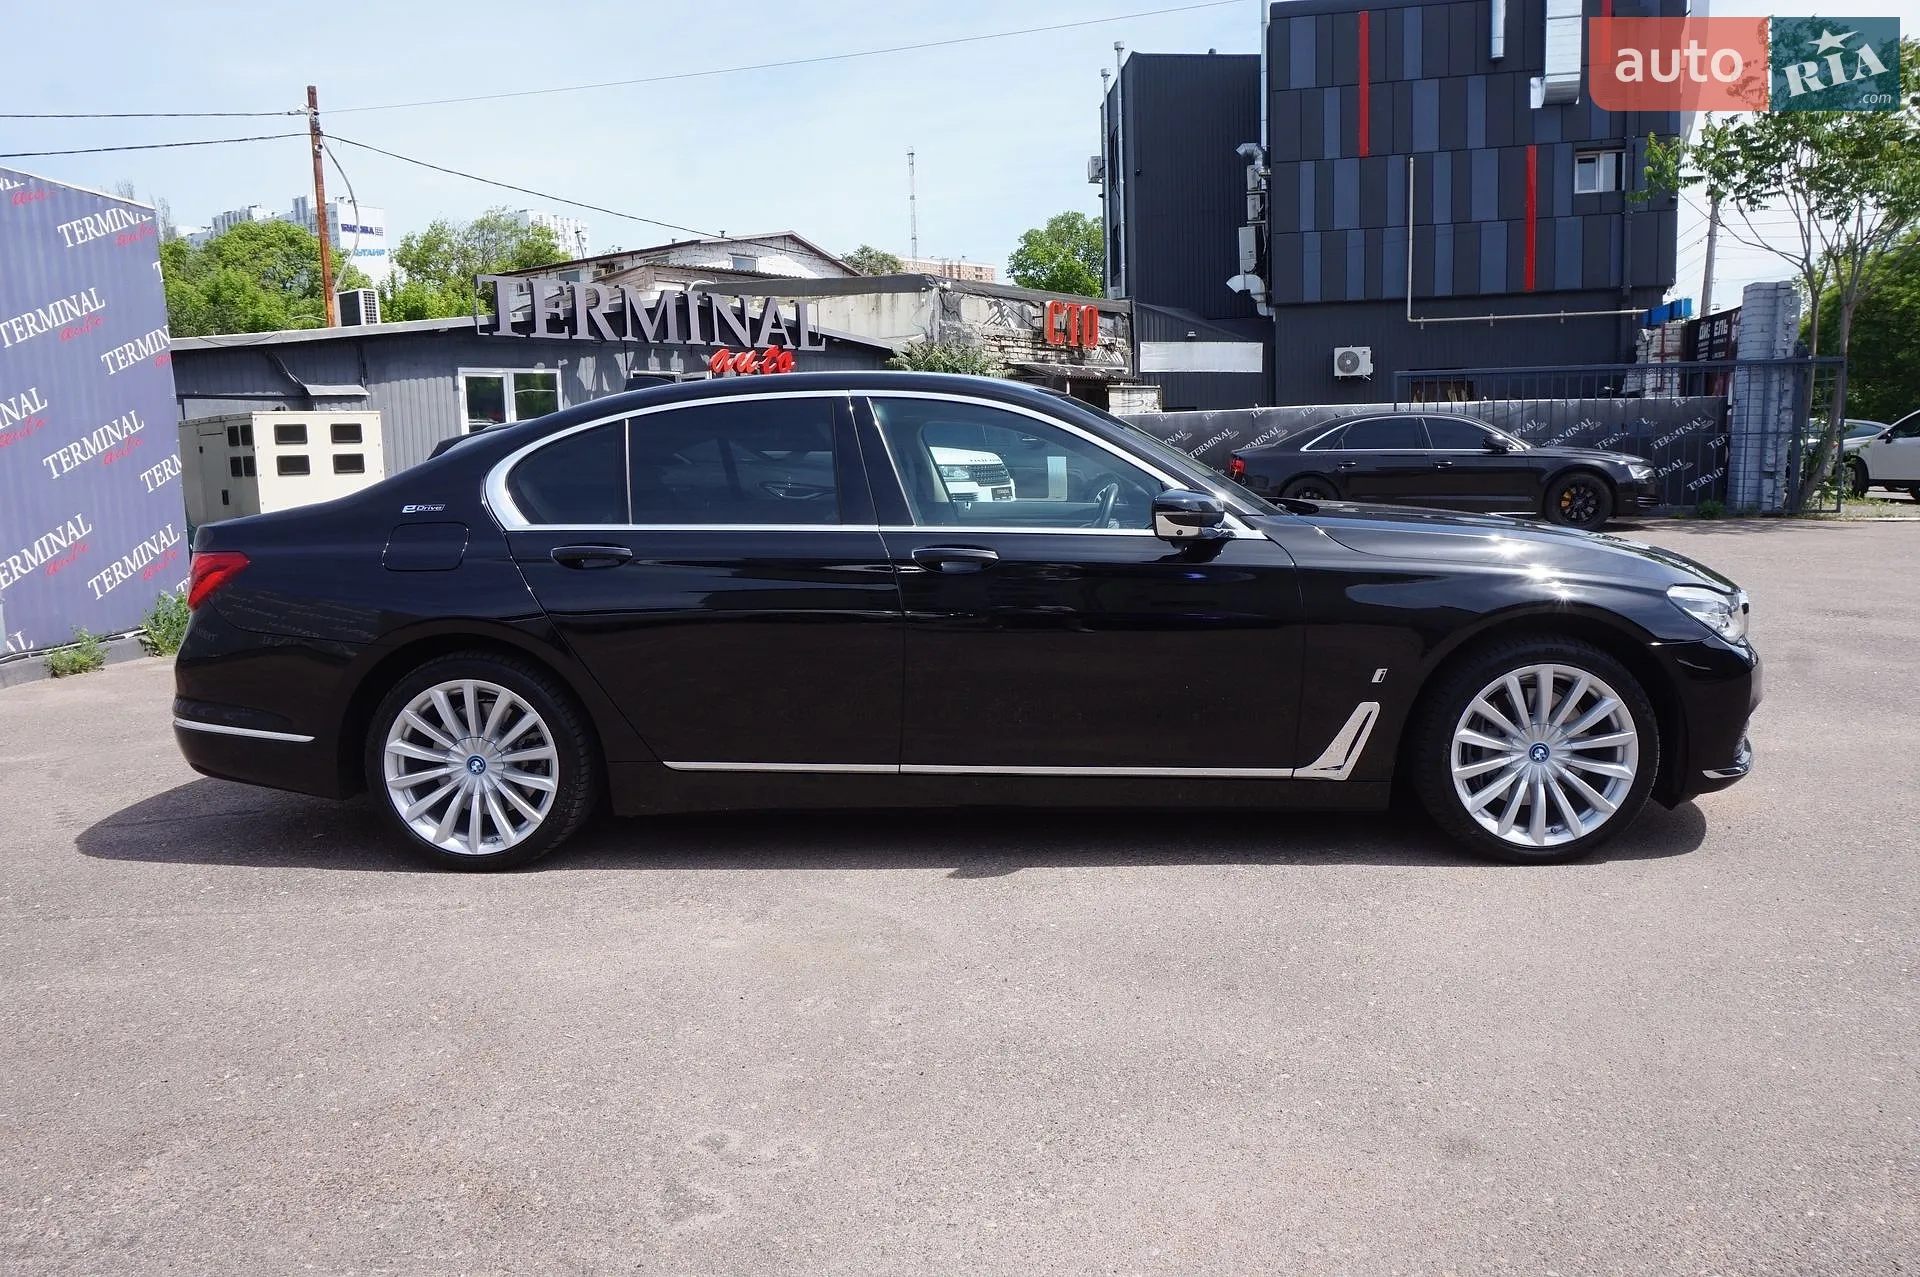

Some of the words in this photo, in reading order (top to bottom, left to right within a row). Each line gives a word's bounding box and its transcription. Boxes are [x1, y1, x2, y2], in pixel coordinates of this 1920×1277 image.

[0, 287, 106, 348] TERMINAL
[474, 275, 825, 352] TERMINAL
[1044, 300, 1099, 348] СТО
[709, 345, 796, 374] auto
[42, 409, 145, 480] TERMINAL
[1189, 427, 1233, 459] TERMINAL
[87, 523, 180, 601] TERMINAL
